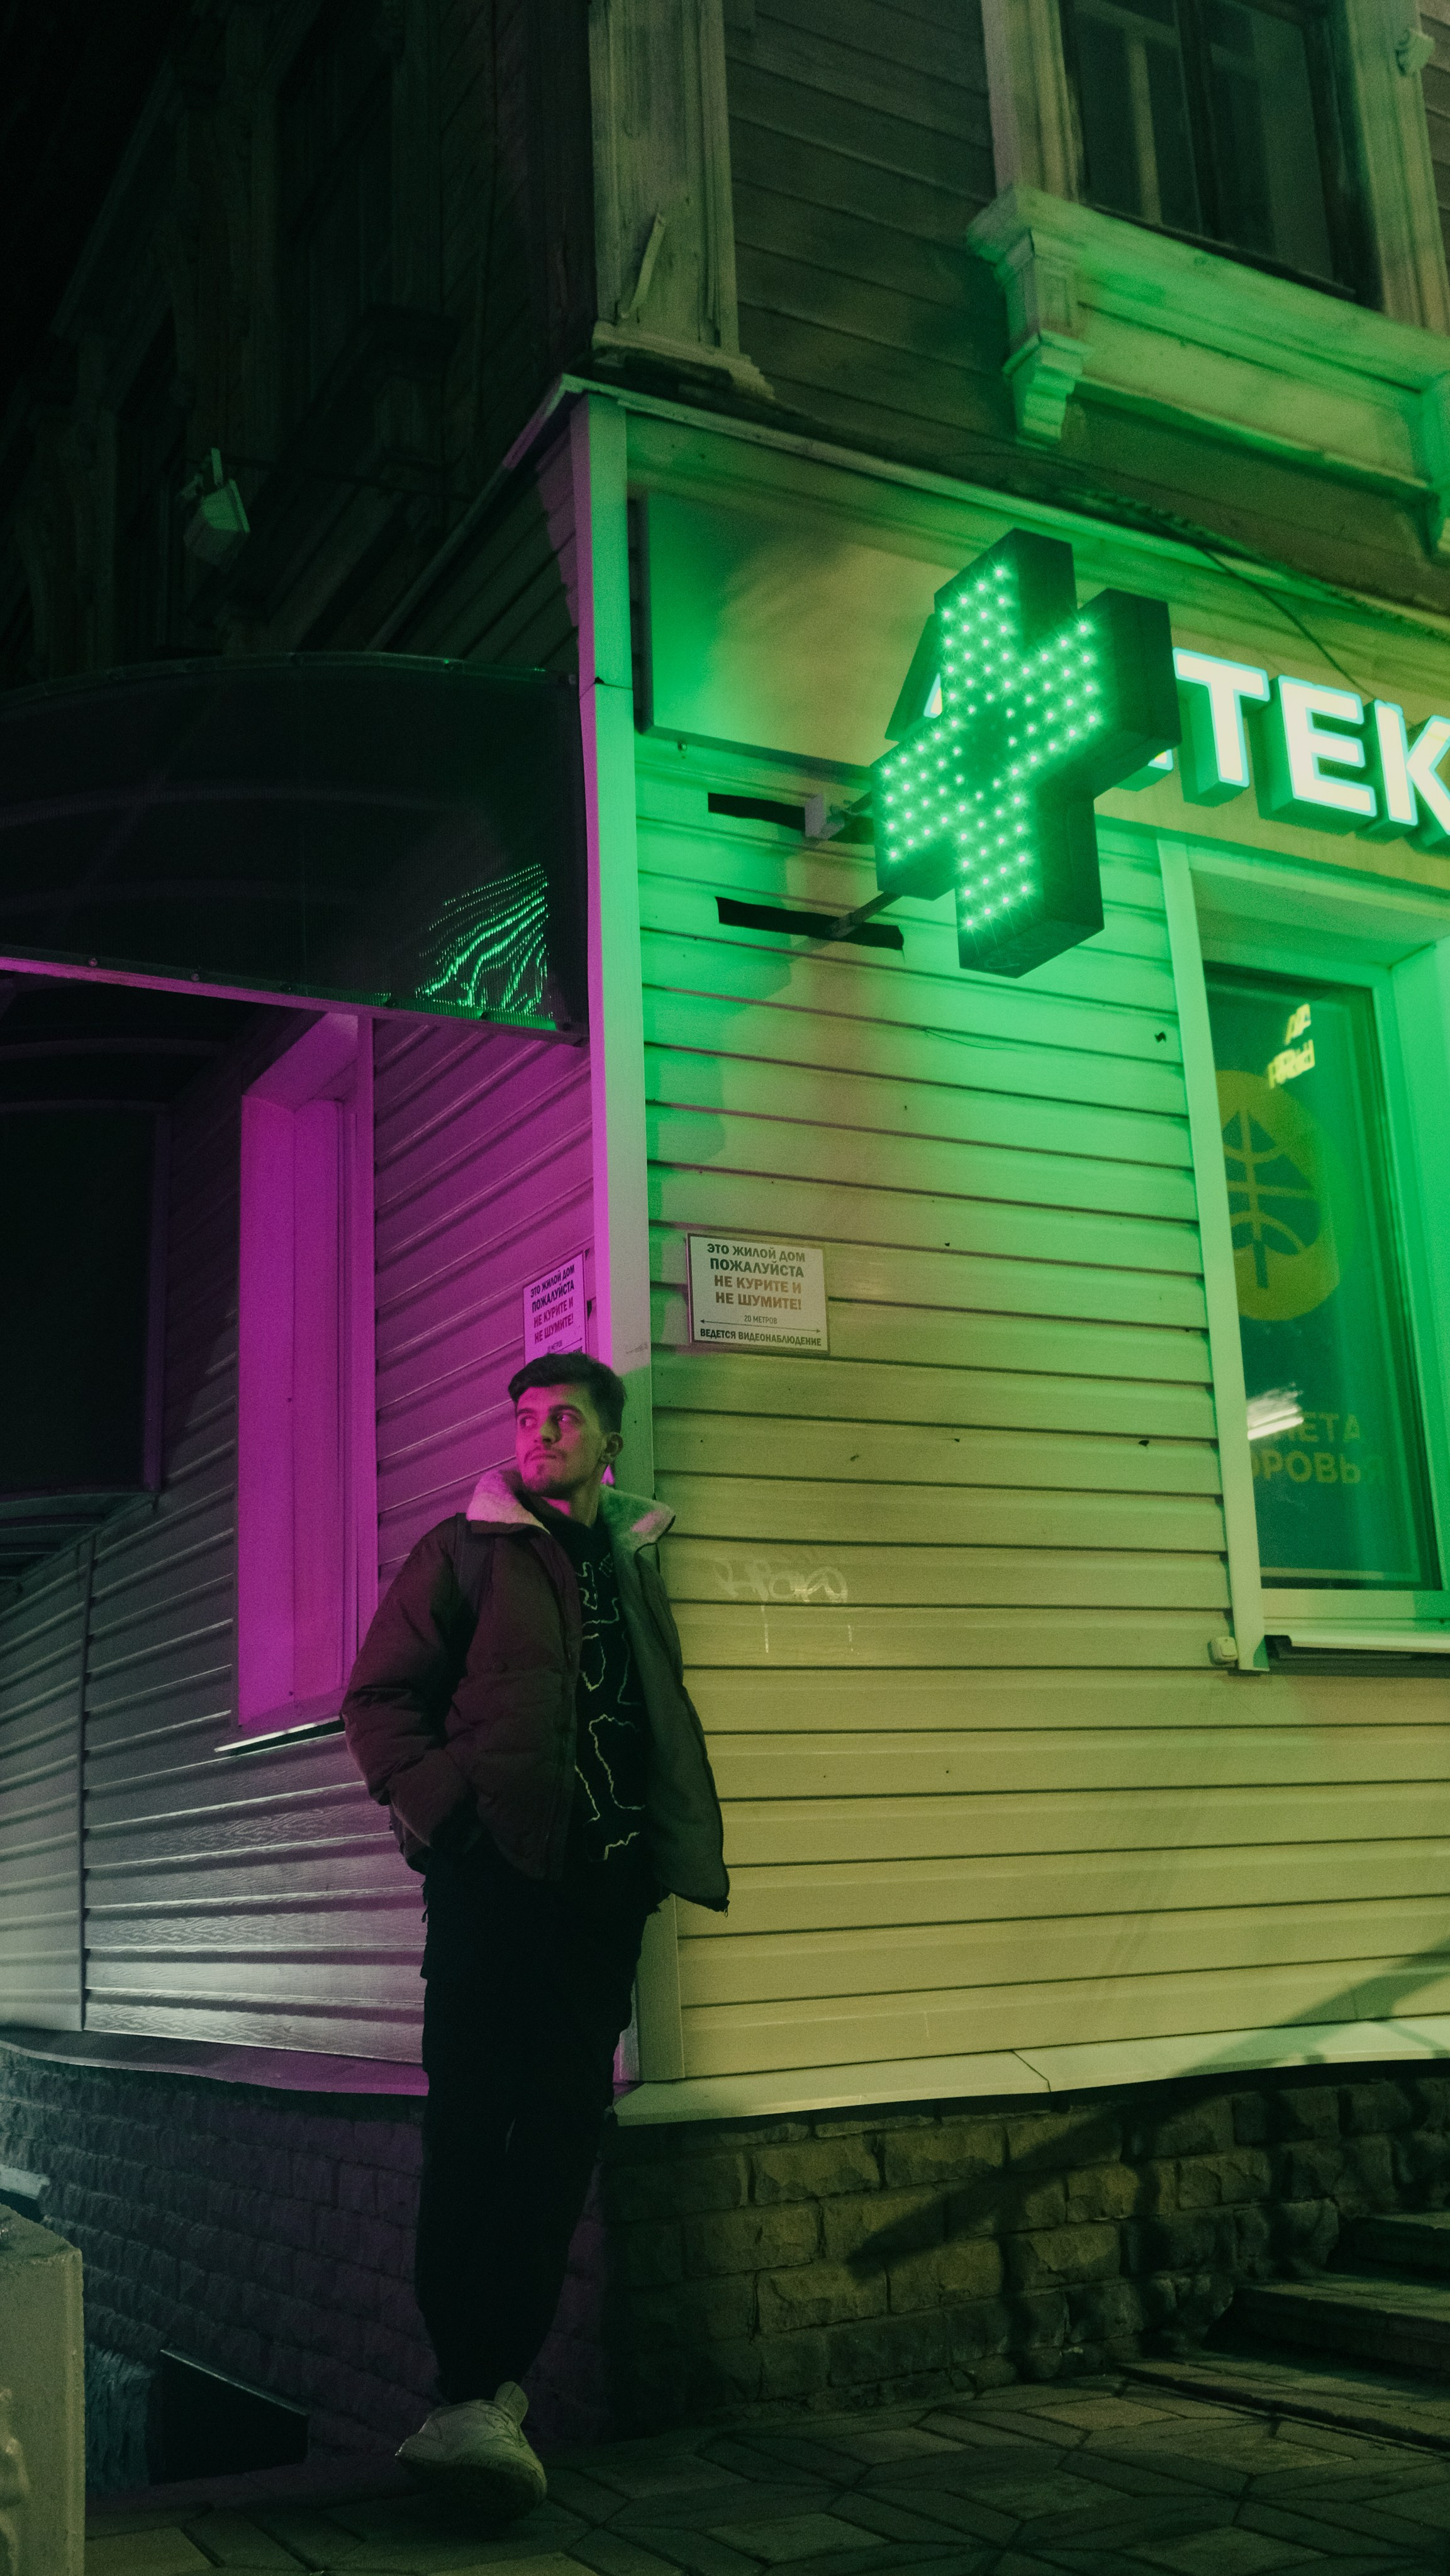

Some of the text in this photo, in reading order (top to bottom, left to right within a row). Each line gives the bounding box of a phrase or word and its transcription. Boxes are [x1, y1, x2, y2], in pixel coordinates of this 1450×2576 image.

[707, 1243, 805, 1263] ЭТО ЖИЛОЙ ДОМ
[710, 1258, 805, 1278] ПОЖАЛУЙСТА
[530, 1264, 575, 1297] ЭТО ЖИЛОЙ ДОМ
[714, 1275, 801, 1294] НЕ КУРИТЕ И
[532, 1279, 575, 1313] ПОЖАЛУЙСТА
[716, 1292, 802, 1310] НЕ ШУМИТЕ!
[533, 1296, 574, 1329] НЕ КУРИТЕ И
[753, 1316, 778, 1324] МЕТРОВ
[535, 1313, 574, 1344] НЕ ШУМИТЕ!
[700, 1328, 822, 1347] ВЕДЕТСЯ ВИДЕОНАБЛЮДЕНИЕ
